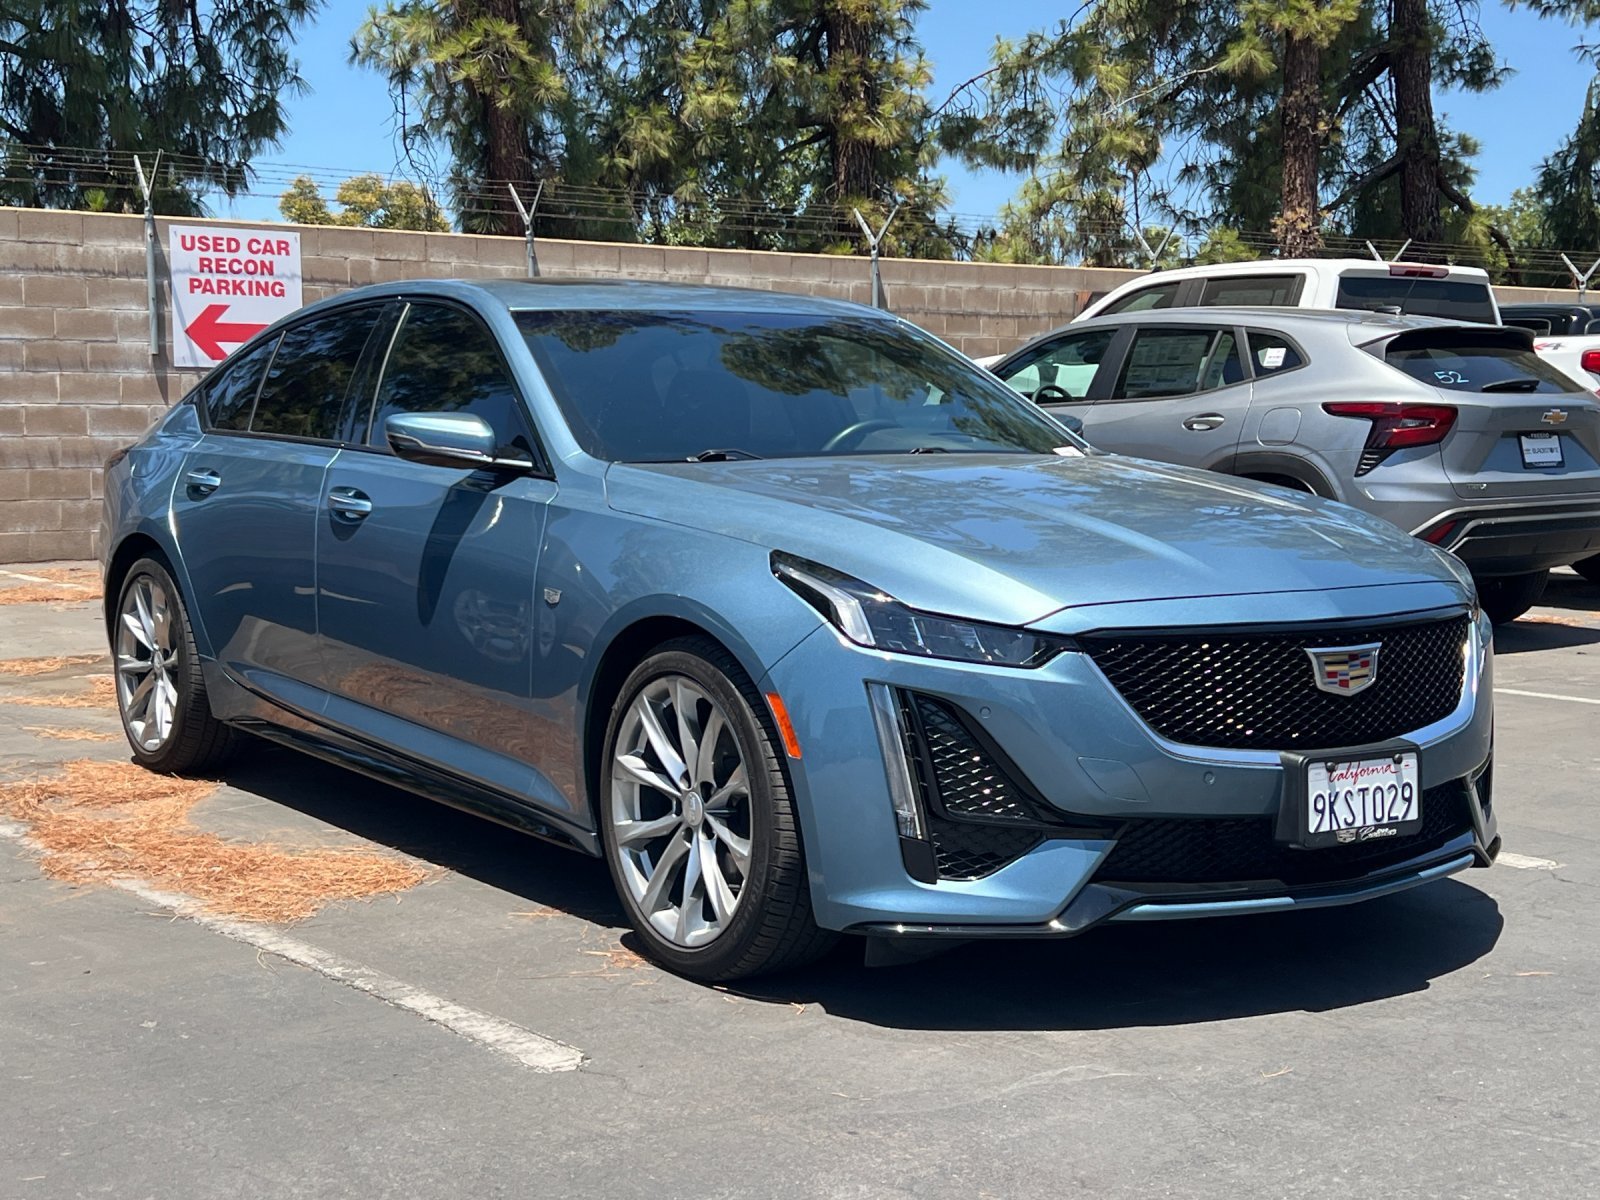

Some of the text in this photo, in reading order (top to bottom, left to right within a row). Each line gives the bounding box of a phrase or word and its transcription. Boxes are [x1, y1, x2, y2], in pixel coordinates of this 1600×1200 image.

[180, 235, 290, 256] USED CAR
[199, 257, 274, 276] RECON
[189, 278, 285, 297] PARKING
[1434, 371, 1469, 384] 52
[1328, 761, 1399, 785] California
[1313, 781, 1413, 832] 9KST029
